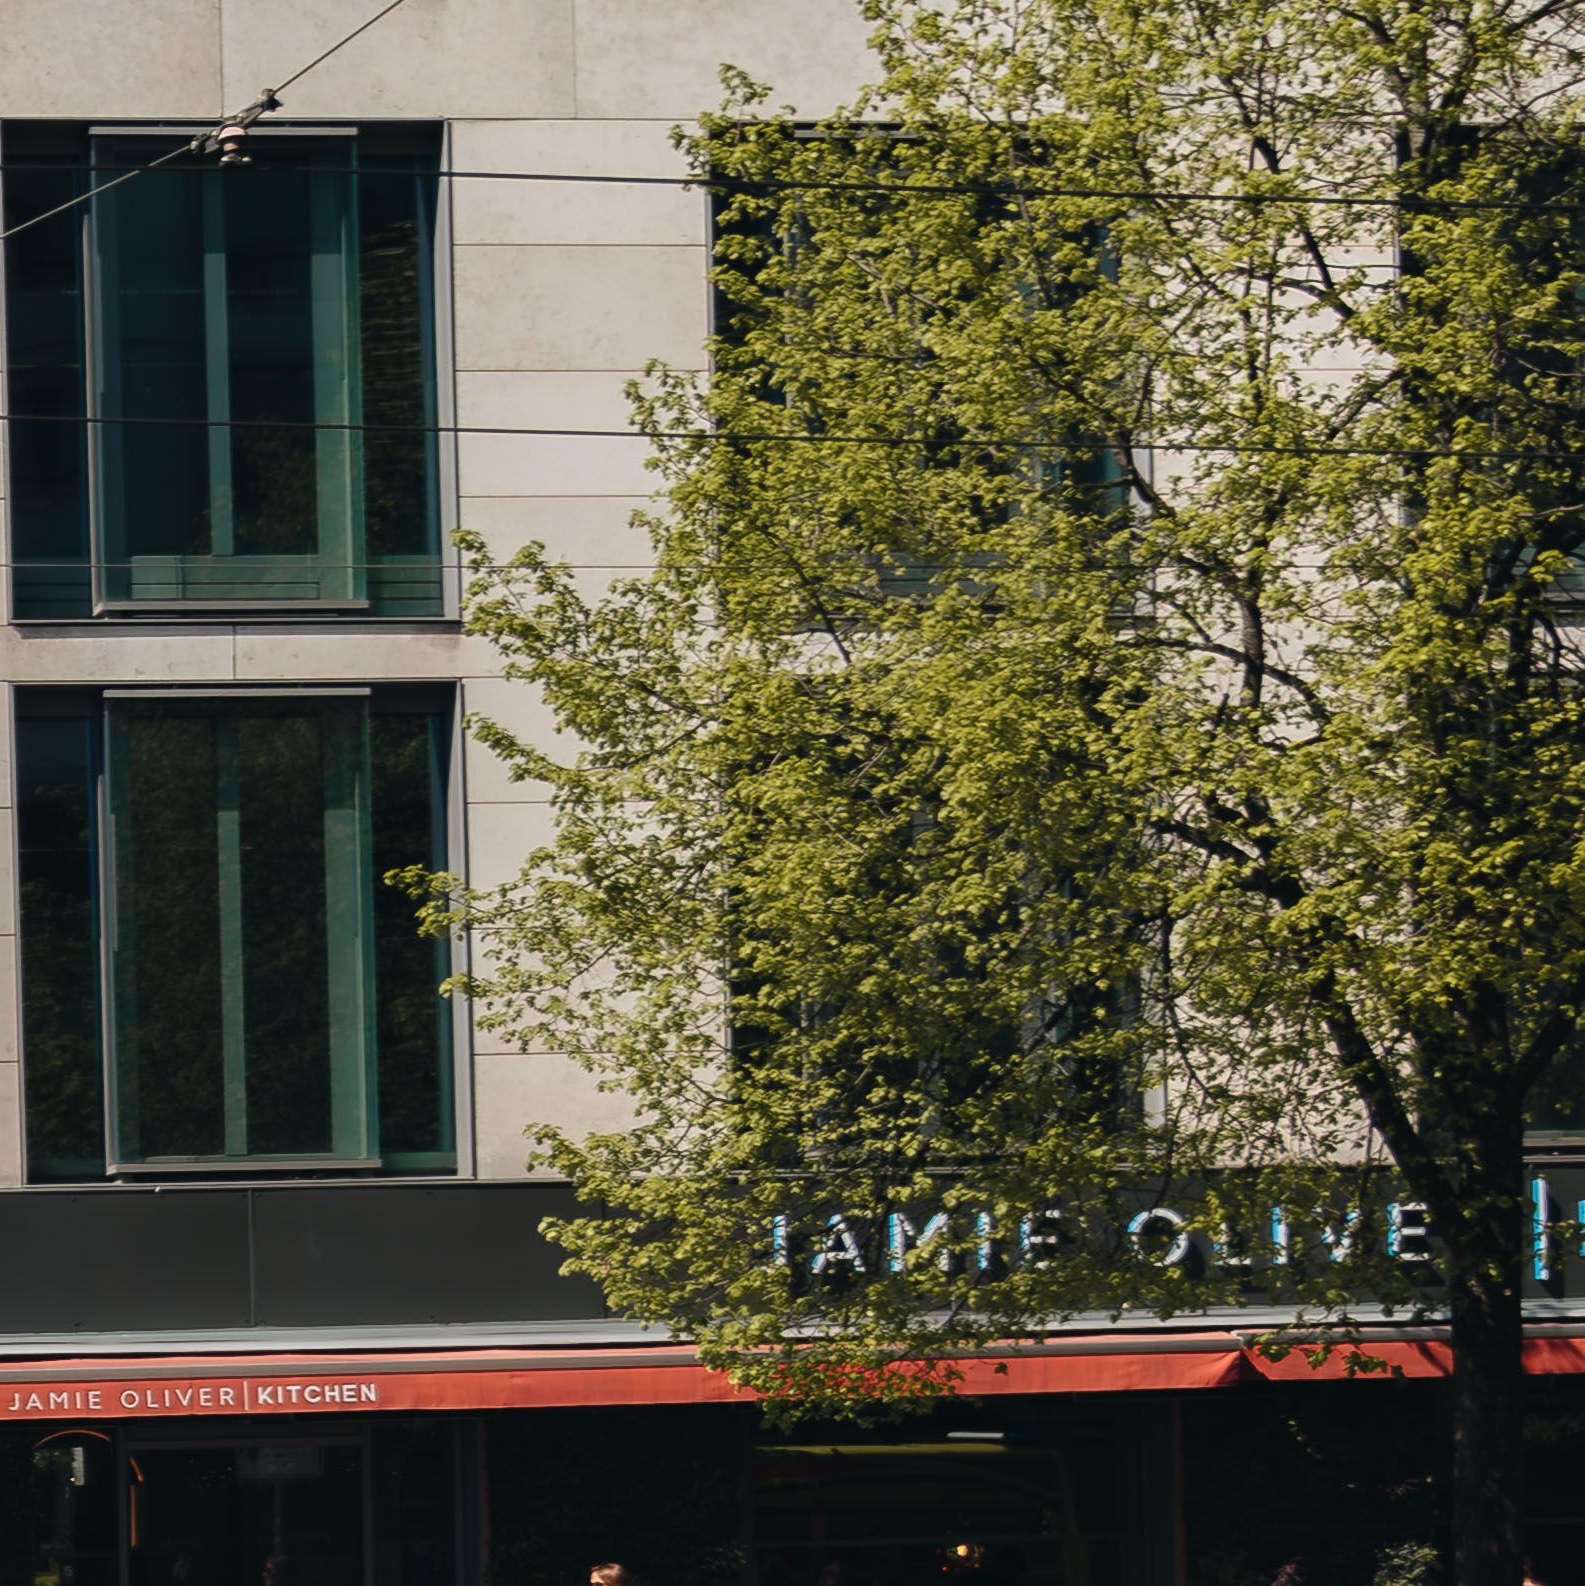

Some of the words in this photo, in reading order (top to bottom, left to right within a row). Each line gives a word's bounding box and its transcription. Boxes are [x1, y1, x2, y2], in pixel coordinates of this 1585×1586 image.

[8, 1390, 102, 1411] JAMIE
[120, 1387, 235, 1409] OLIVER
[258, 1383, 377, 1405] KITCHEN
